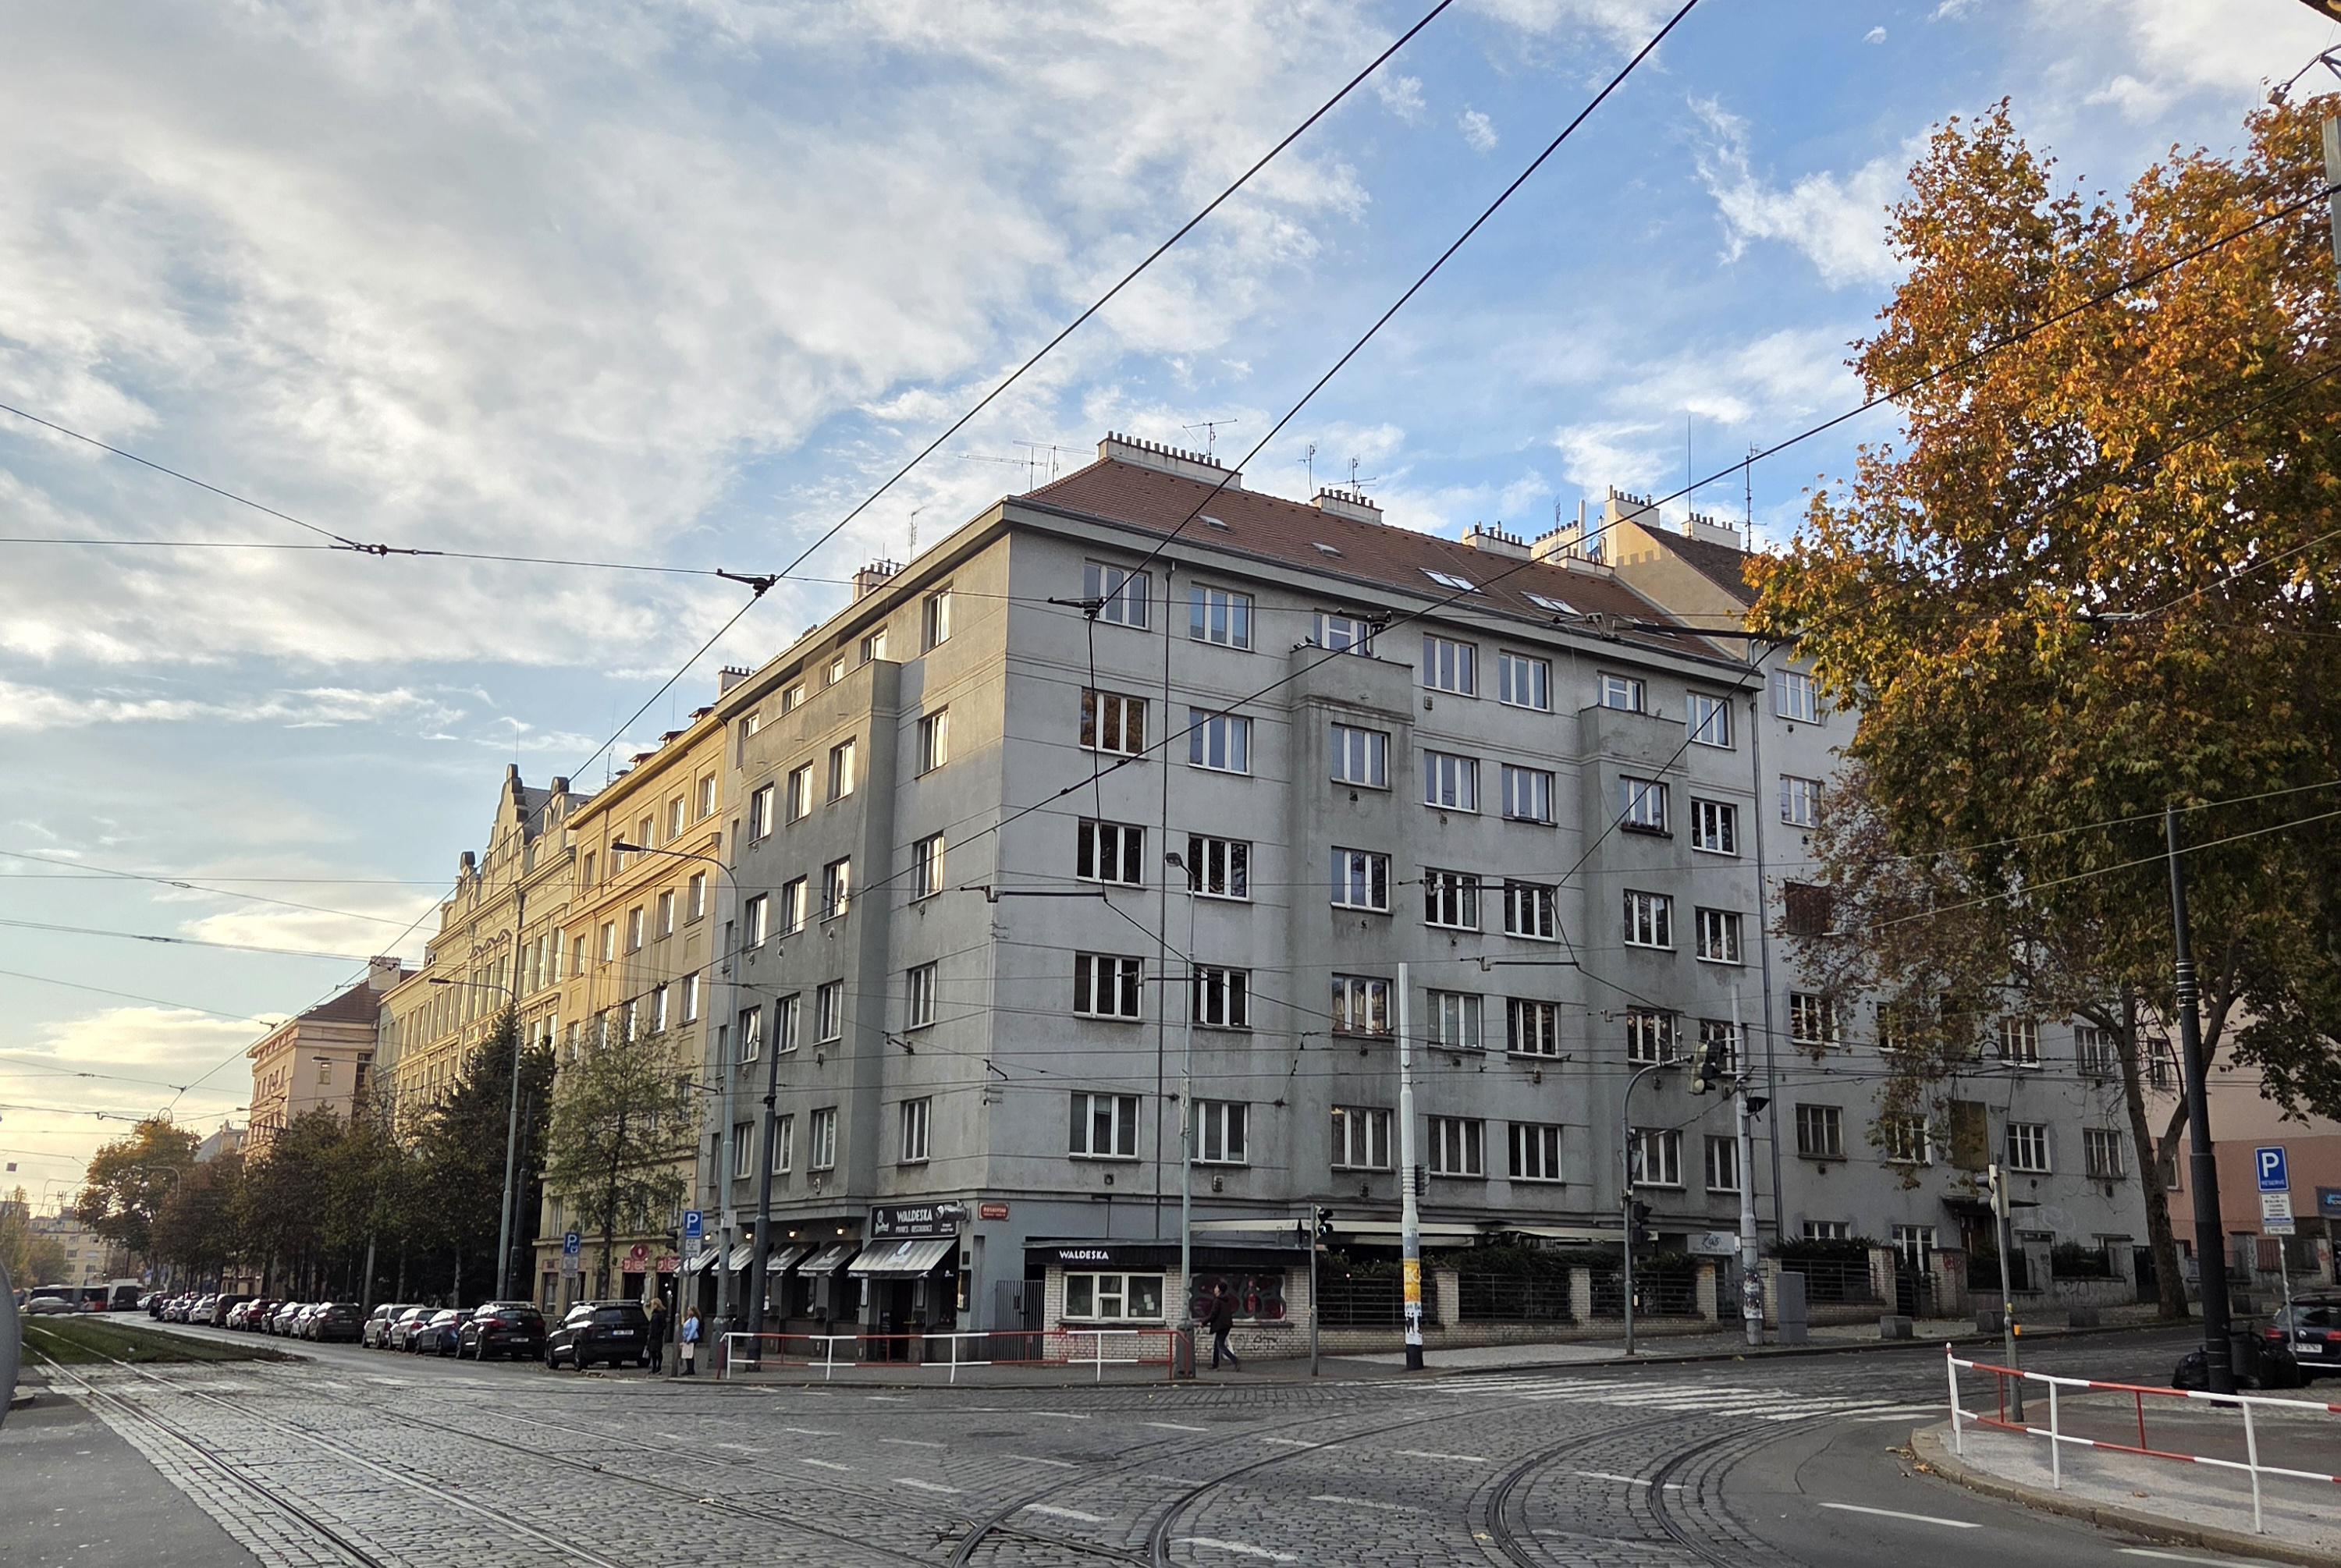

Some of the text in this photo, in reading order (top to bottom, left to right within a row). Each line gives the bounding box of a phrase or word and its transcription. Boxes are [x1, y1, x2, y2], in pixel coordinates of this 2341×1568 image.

[2261, 1152, 2279, 1178] P
[687, 1213, 698, 1229] P
[897, 1208, 932, 1222] WALDESKA
[567, 1234, 577, 1247] P
[1059, 1250, 1109, 1260] WALDESKA
